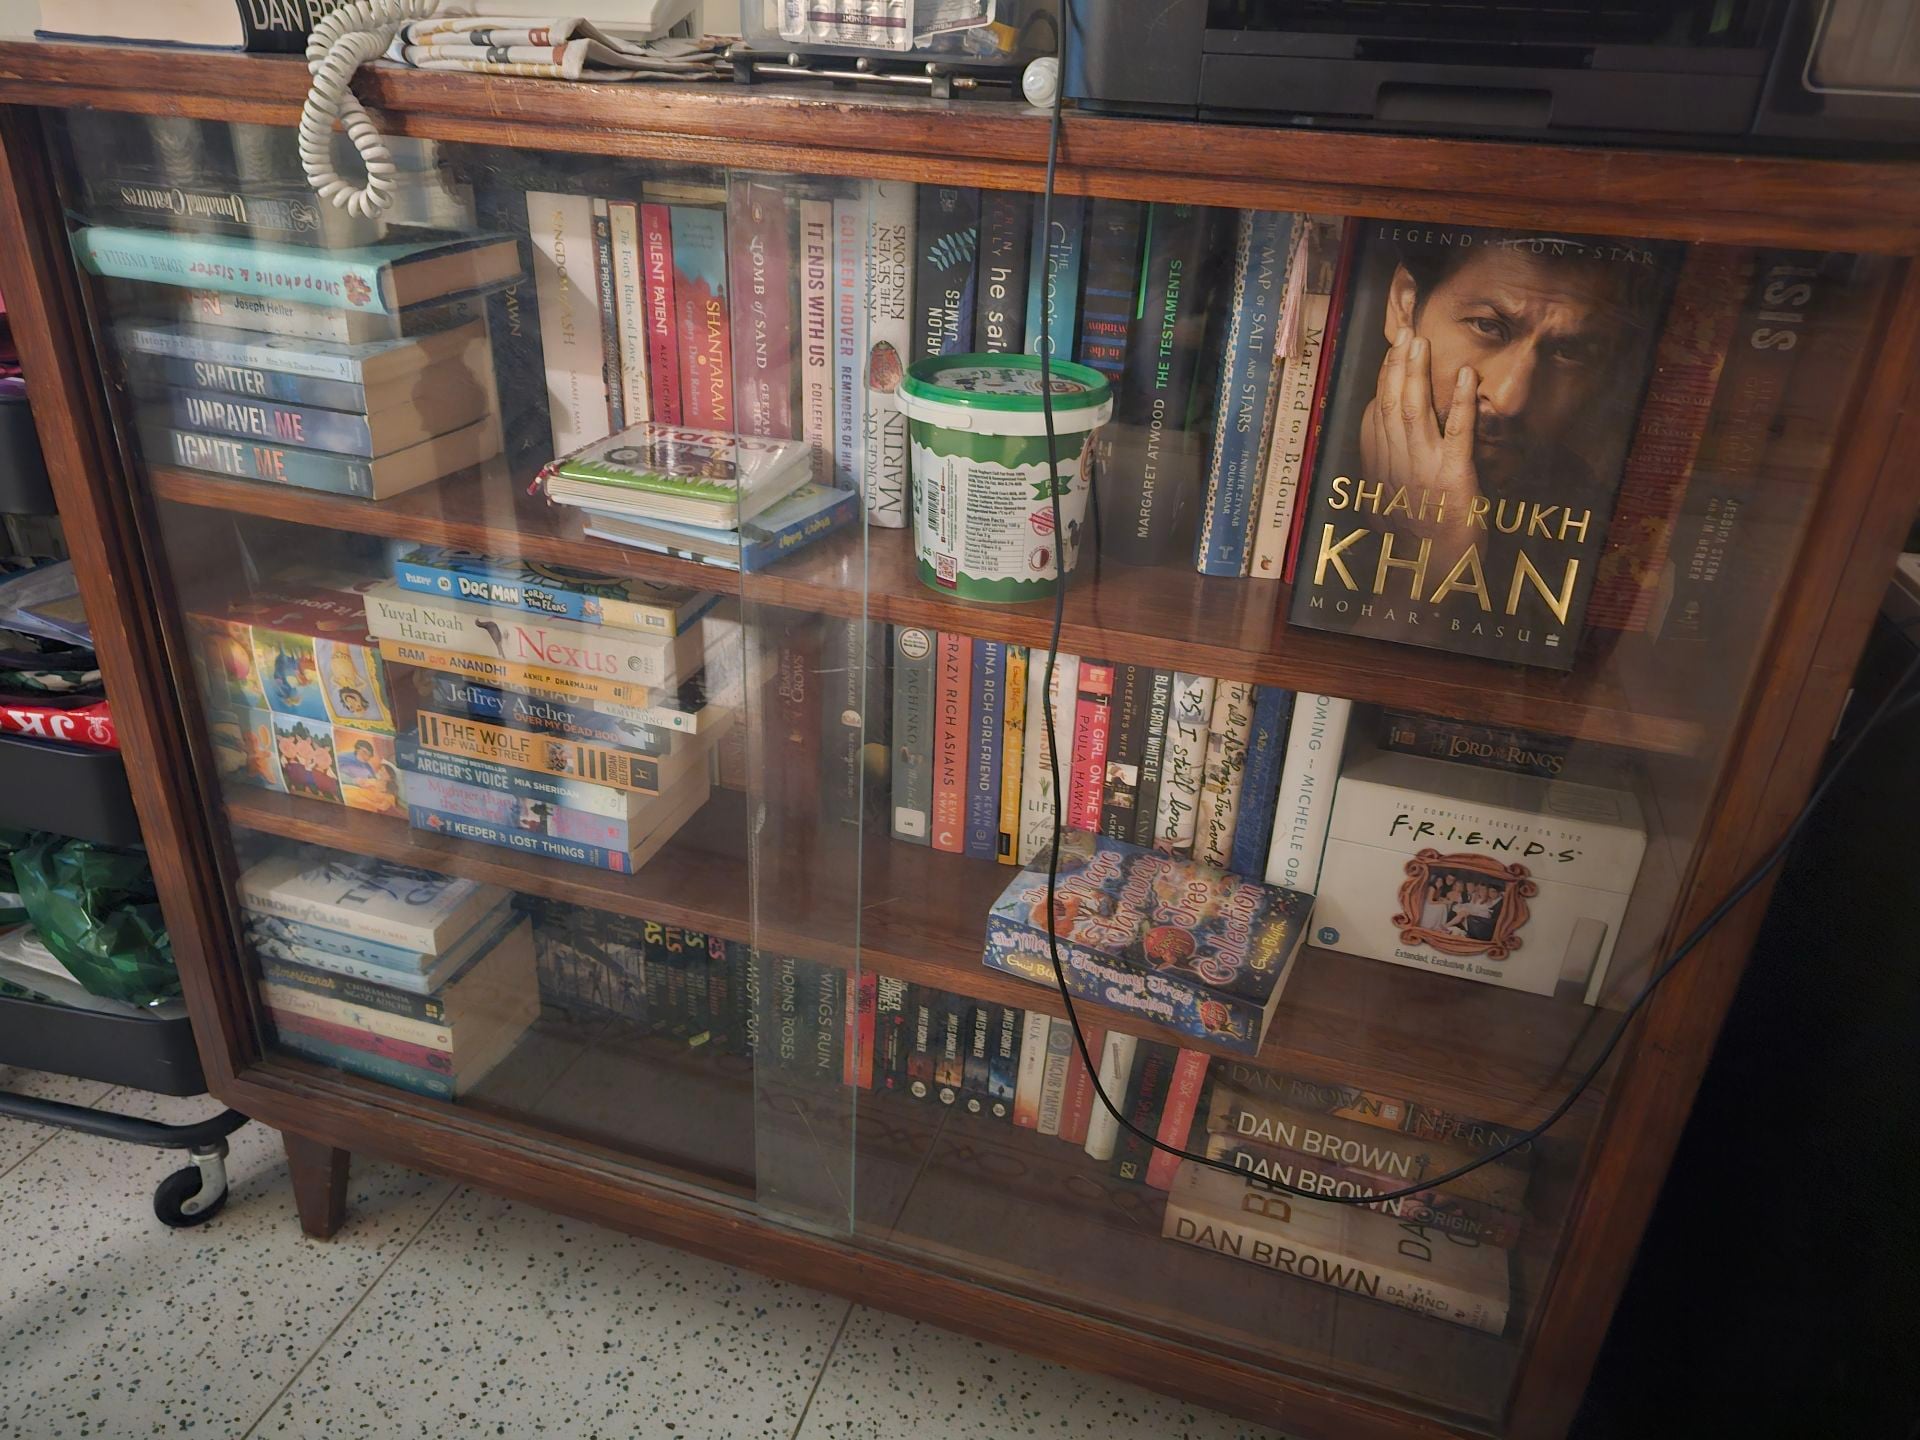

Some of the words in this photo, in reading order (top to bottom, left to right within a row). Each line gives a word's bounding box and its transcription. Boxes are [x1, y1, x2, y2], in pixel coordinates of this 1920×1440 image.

[807, 221, 825, 241] IT
[839, 214, 857, 288] COLLEEN
[1377, 225, 1474, 249] LEGEND
[1591, 245, 1656, 265] STAR
[599, 244, 610, 265] THE
[649, 231, 665, 282] SILENT
[752, 241, 767, 296] TOMB
[807, 244, 825, 290] ENDS
[876, 226, 892, 284] SEVEN
[891, 224, 907, 321] KINGDOMS
[1058, 243, 1073, 270] THE
[1256, 246, 1276, 290] MAP
[600, 266, 612, 314] PROPHET
[622, 283, 636, 315] Rules
[880, 288, 892, 318] THE
[988, 266, 1012, 300] he
[233, 296, 266, 313] Joseph
[652, 285, 668, 336] PATIENT
[808, 294, 826, 340] WITH
[943, 289, 961, 342] JAMES
[1158, 259, 1183, 358] TESTAMENTS
[754, 319, 768, 369] SAND
[839, 293, 856, 357] HOOVER
[926, 307, 943, 357] ARLON
[1247, 312, 1267, 353] SALT
[627, 335, 640, 362] Love
[704, 300, 726, 421] SHANTARAM
[809, 345, 826, 368] US
[1245, 357, 1258, 380] AND
[1292, 326, 1323, 411] Married
[193, 361, 267, 396] SHATTER
[1154, 361, 1171, 390] THE
[811, 382, 823, 430] COLLEEN
[840, 365, 853, 432] REMINDERS
[1236, 383, 1257, 433] STARS
[186, 398, 273, 437] UNRAVEL
[274, 410, 306, 442] ME
[1145, 398, 1166, 461] ATWOOD
[1289, 419, 1303, 434] to
[176, 433, 247, 475] IGNITE
[253, 447, 288, 482] ME
[841, 434, 852, 449] OF
[841, 450, 853, 473] HIM
[879, 408, 905, 514] MARTIN
[1136, 464, 1158, 539] MARGARET
[1271, 452, 1301, 530] Bedouin
[1327, 476, 1448, 524] SHAH
[1466, 494, 1592, 544] RUKH
[1312, 523, 1581, 627] KHAN
[1703, 547, 1725, 583] STERN
[457, 576, 490, 599] DOG
[491, 583, 520, 604] MAN
[377, 602, 419, 624] Yuval
[423, 609, 464, 632] Noah
[399, 621, 448, 644] Harari
[1308, 595, 1420, 626] MOHAR
[1450, 617, 1531, 647] BASU
[397, 646, 426, 662] RAM
[448, 656, 508, 677] ANANDHI
[514, 626, 619, 674] Nexus
[944, 632, 960, 683] CRAZY
[983, 641, 997, 676] HINA
[445, 683, 506, 713] Jeffrey
[512, 697, 576, 724] Archer
[906, 667, 920, 745] PACHINKO
[944, 688, 958, 727] RICH
[983, 679, 996, 712] RICH
[1093, 696, 1108, 721] THE
[1151, 674, 1169, 708] BLACK
[563, 724, 593, 737] DEAD
[1147, 708, 1166, 736] CROW
[1177, 721, 1198, 743] I
[1225, 704, 1249, 727] all
[441, 721, 475, 738] THE
[479, 730, 531, 752] WOLF
[442, 736, 458, 747] OF
[459, 741, 492, 757] WALL
[495, 748, 531, 764] STREET
[979, 715, 996, 792] GIRLFRIEND
[1077, 714, 1090, 763] PAULA
[1090, 727, 1105, 761] GIRL
[1117, 732, 1129, 758] WIFE
[1144, 737, 1162, 767] WHITE
[1220, 728, 1245, 754] the
[1448, 735, 1494, 758] LORD
[1506, 744, 1565, 774] RINGS
[607, 754, 617, 783] JORDAN
[942, 730, 956, 786] ASIANS
[1089, 763, 1104, 785] ON
[1142, 767, 1158, 783] LIE
[1165, 744, 1199, 793] still
[1212, 756, 1241, 795] boys
[417, 757, 473, 781] ARCHER'S
[474, 770, 510, 789] VOICE
[514, 778, 532, 789] MIA
[532, 780, 580, 800] SHERIDAN
[948, 791, 959, 826] KEVIN
[971, 794, 982, 826] KWAN
[982, 794, 993, 828] KEVIN
[1086, 788, 1101, 815] THE
[1165, 795, 1193, 841] love
[1289, 773, 1316, 851] MICHELLE
[454, 820, 503, 841] KEEPER
[509, 836, 539, 850] LOST
[541, 840, 586, 860] THINGS
[1206, 818, 1225, 855] loved
[1056, 850, 1123, 902] Magic
[1084, 853, 1173, 948] Faraway
[1153, 878, 1210, 929] Tree
[1196, 881, 1264, 986] Collection
[781, 958, 795, 1013] THORNS
[877, 975, 890, 1012] GAMES
[1070, 949, 1146, 993] Faraway
[1146, 975, 1195, 1006] Tree
[817, 973, 833, 1026] WINGS
[974, 1007, 988, 1031] JAMES
[1001, 1007, 1015, 1031] JAMES
[1105, 987, 1176, 1017] Collection
[780, 1016, 796, 1061] ROSES
[816, 1031, 833, 1070] RUIN
[972, 1030, 986, 1059] DASHNER
[999, 1030, 1013, 1058] DASHNER
[1182, 1058, 1199, 1080] THE
[1179, 1080, 1194, 1099] SIX
[1230, 1065, 1285, 1091] DAN
[1289, 1078, 1383, 1118] BROWN
[1040, 1089, 1059, 1131] MAHFOUZ
[1236, 1110, 1298, 1148] DAN
[1300, 1127, 1413, 1180] BROWN
[1233, 1151, 1294, 1190] DAN
[1296, 1168, 1406, 1218] BROWN
[1175, 1216, 1243, 1257] DAN
[1250, 1238, 1382, 1299] BROWN
[1385, 1285, 1406, 1298] DA
